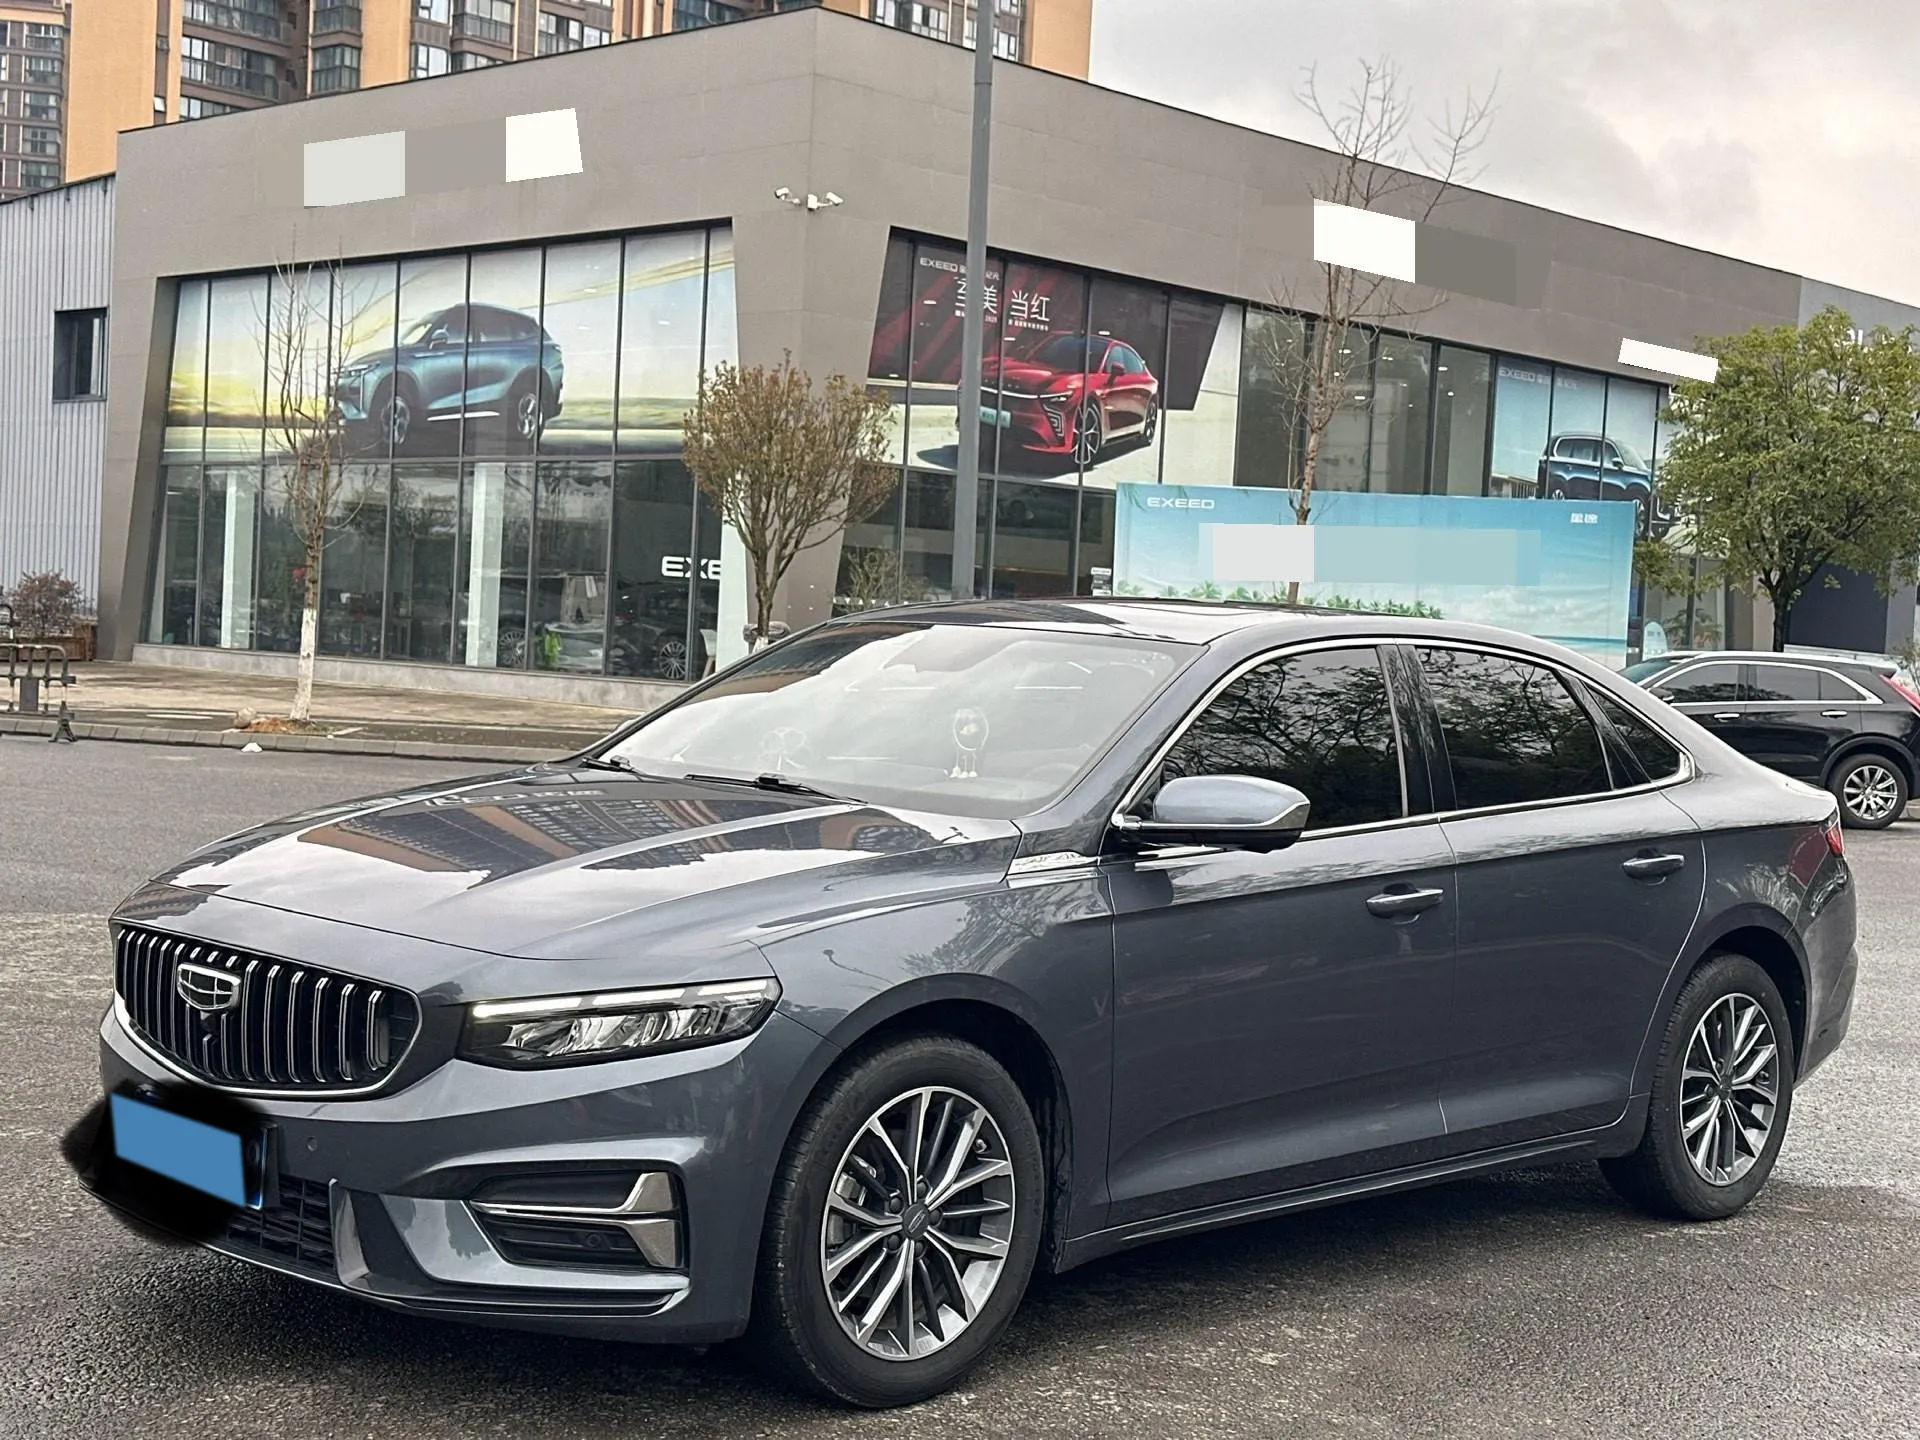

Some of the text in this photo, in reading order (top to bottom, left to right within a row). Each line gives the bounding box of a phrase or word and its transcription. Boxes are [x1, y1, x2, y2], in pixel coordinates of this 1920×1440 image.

[919, 257, 959, 273] EXEED
[1010, 289, 1051, 322] 当红
[1498, 366, 1536, 382] EXEED
[1146, 497, 1215, 510] EXEED
